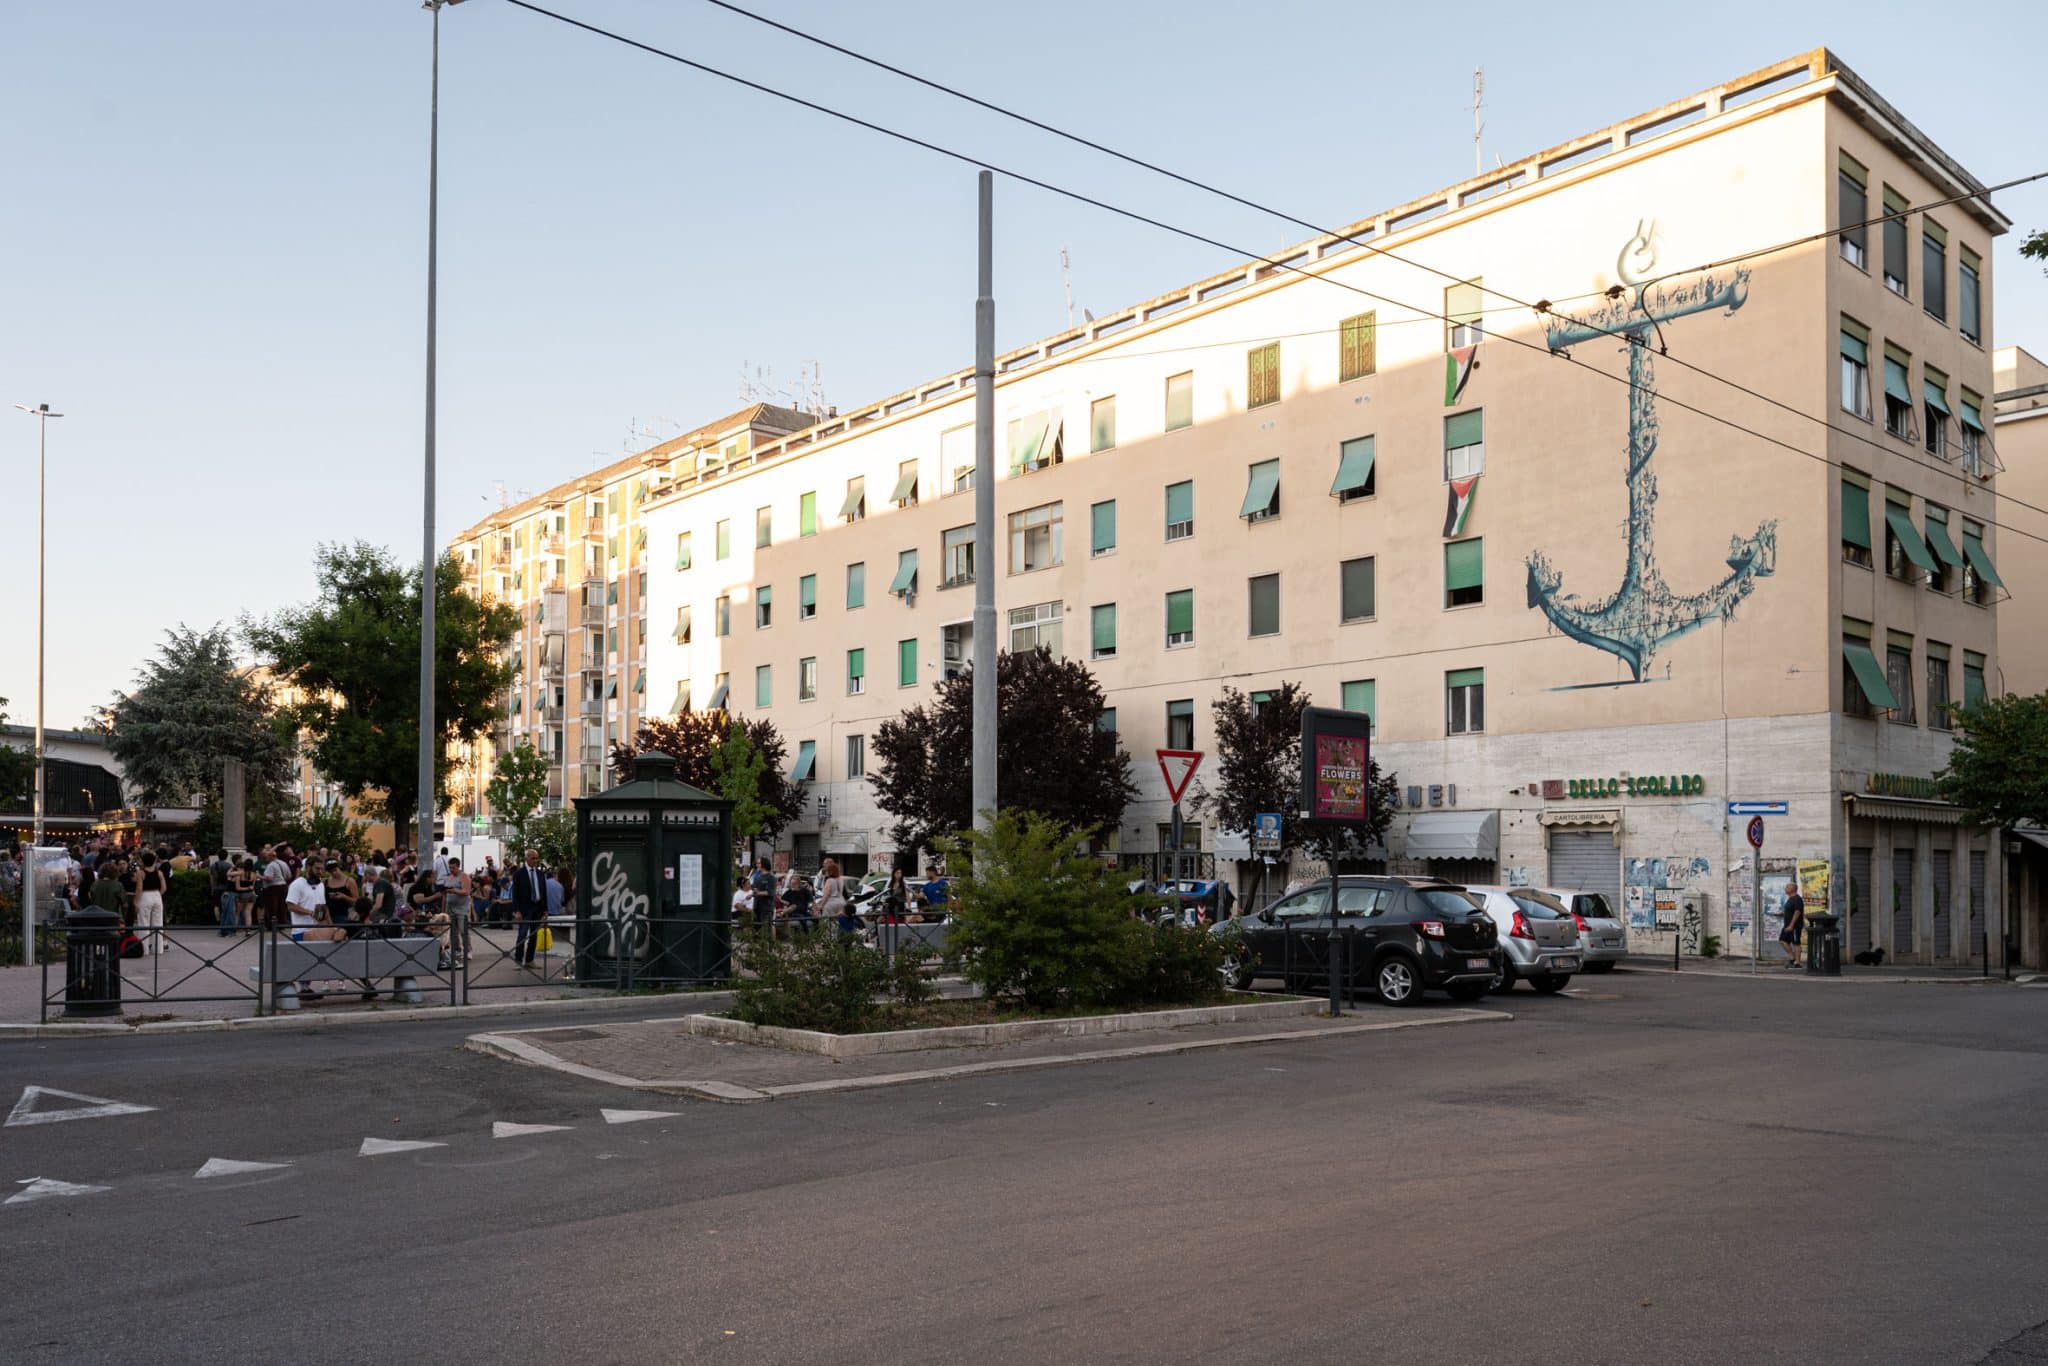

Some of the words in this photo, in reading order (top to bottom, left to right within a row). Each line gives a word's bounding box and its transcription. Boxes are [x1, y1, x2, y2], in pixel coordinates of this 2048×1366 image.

[1321, 768, 1361, 779] FLOWERS
[1568, 777, 1619, 799] DELLO
[1627, 774, 1705, 797] SCOLARO
[1554, 814, 1606, 822] CARTOLIBRERIA
